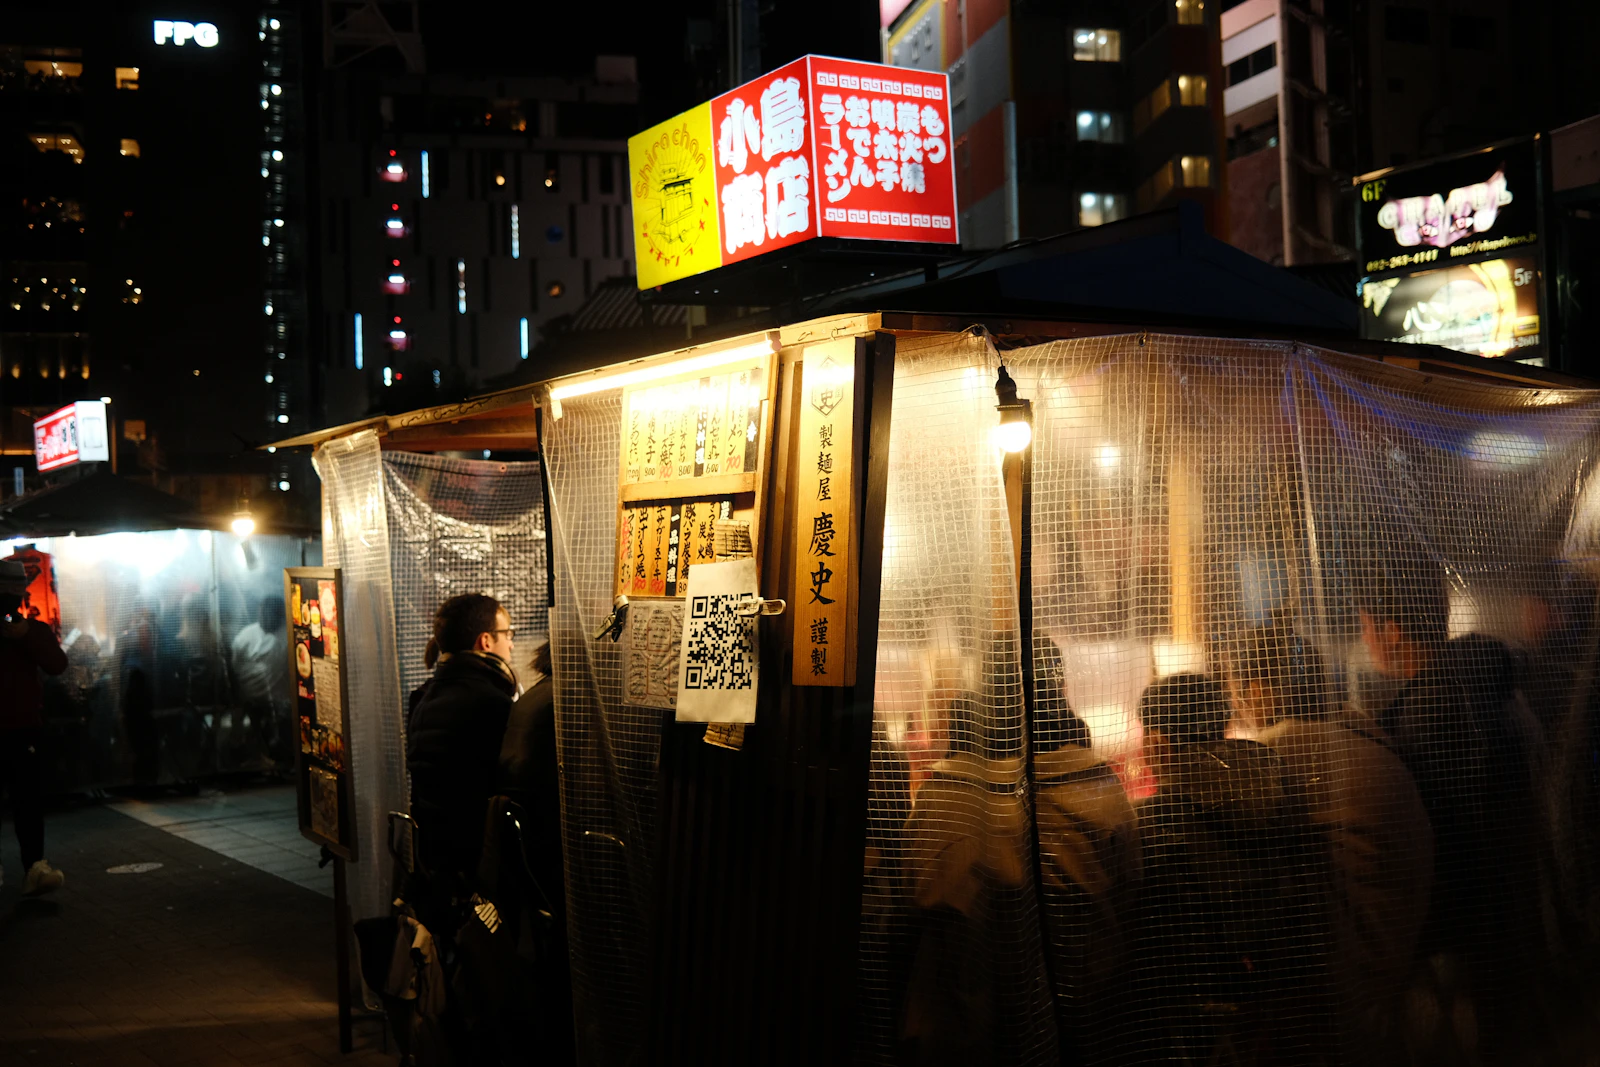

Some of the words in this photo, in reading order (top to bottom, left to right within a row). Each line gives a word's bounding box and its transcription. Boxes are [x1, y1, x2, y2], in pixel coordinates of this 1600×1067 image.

[154, 20, 219, 47] FPG
[718, 77, 804, 174] 小島
[819, 93, 851, 204] ラーメン
[844, 95, 875, 188] おでん
[870, 99, 900, 191] 明太子
[896, 101, 925, 194] 炭火焼
[920, 105, 946, 164] もつ
[721, 155, 809, 254] 商店
[1362, 180, 1385, 202] 6F
[1514, 268, 1533, 287] 5F
[679, 465, 692, 477] 800
[706, 463, 719, 474] 600
[666, 513, 681, 583] 一品料理
[678, 582, 688, 593] 80
